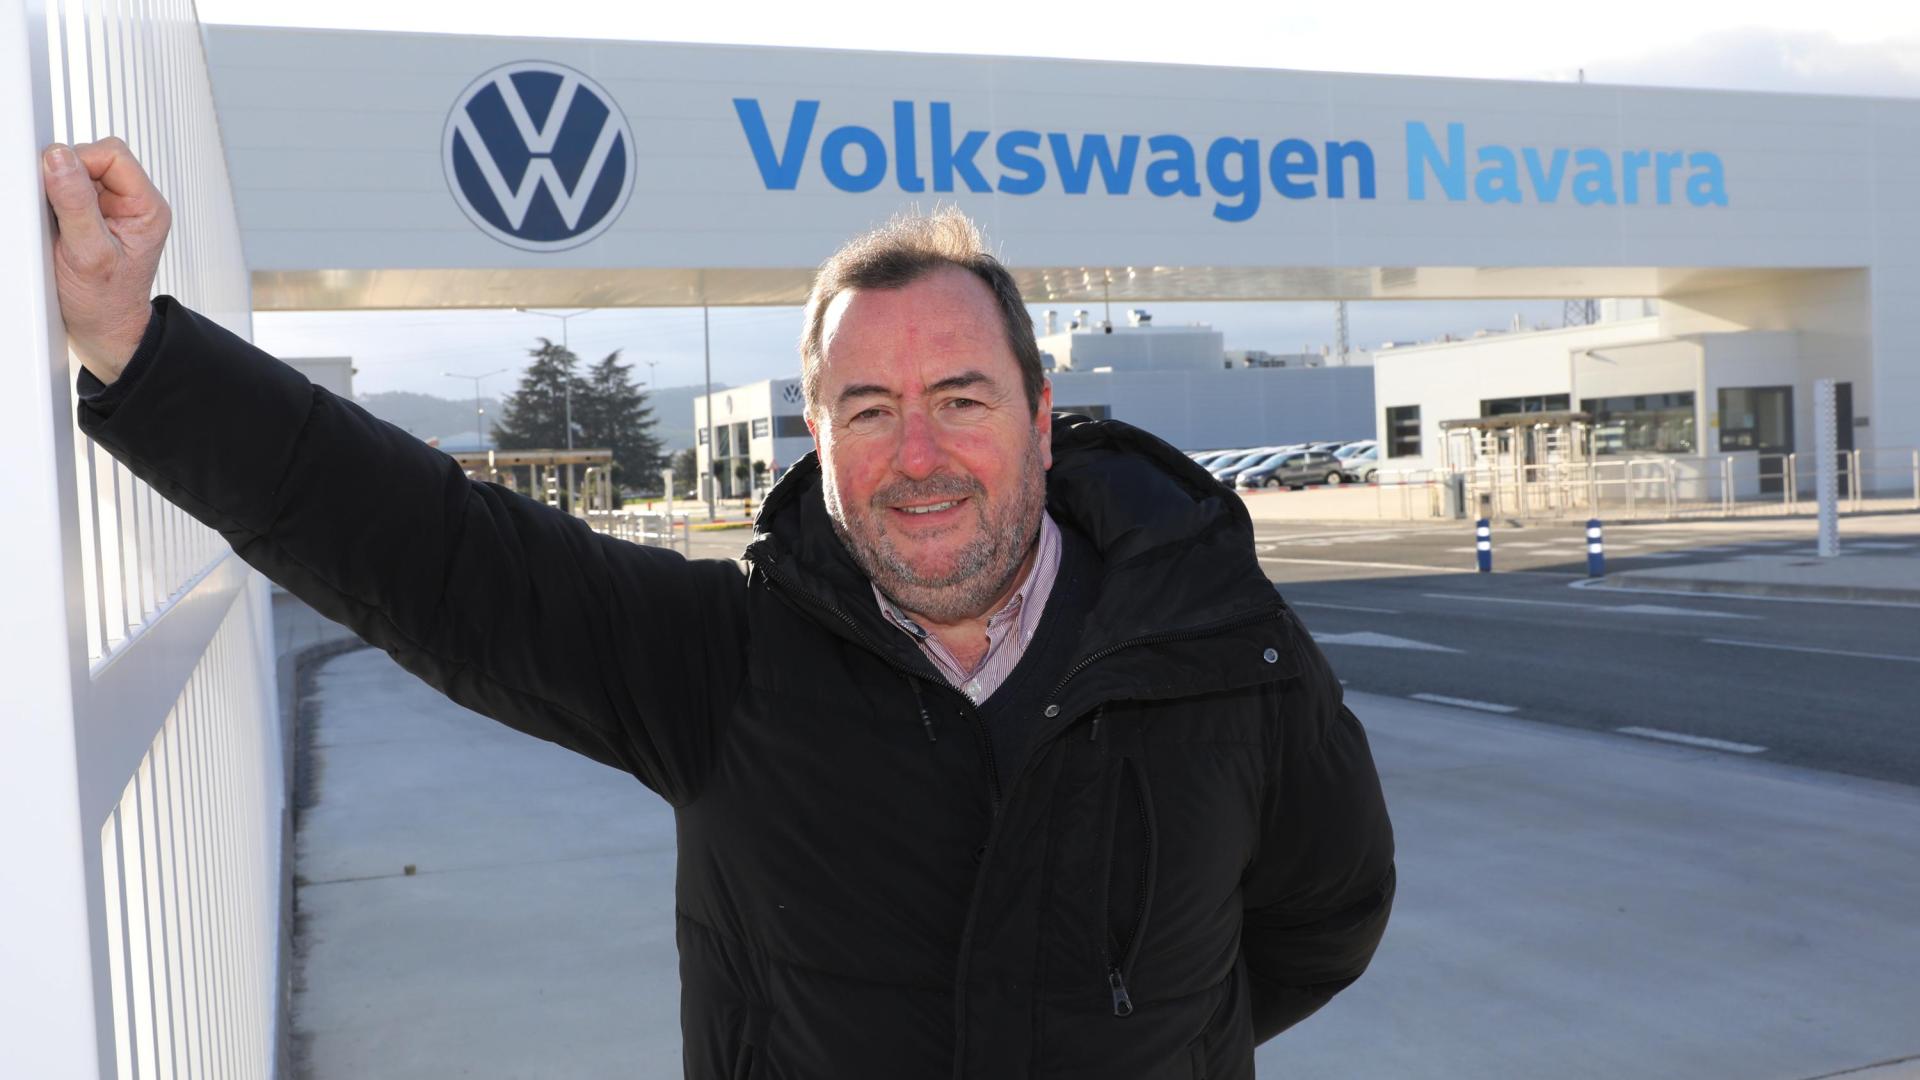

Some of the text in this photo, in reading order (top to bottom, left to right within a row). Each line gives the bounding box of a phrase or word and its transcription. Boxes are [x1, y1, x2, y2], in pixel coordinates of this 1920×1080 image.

[447, 66, 632, 247] VW
[733, 98, 1729, 222] Volkswagen Navarra
